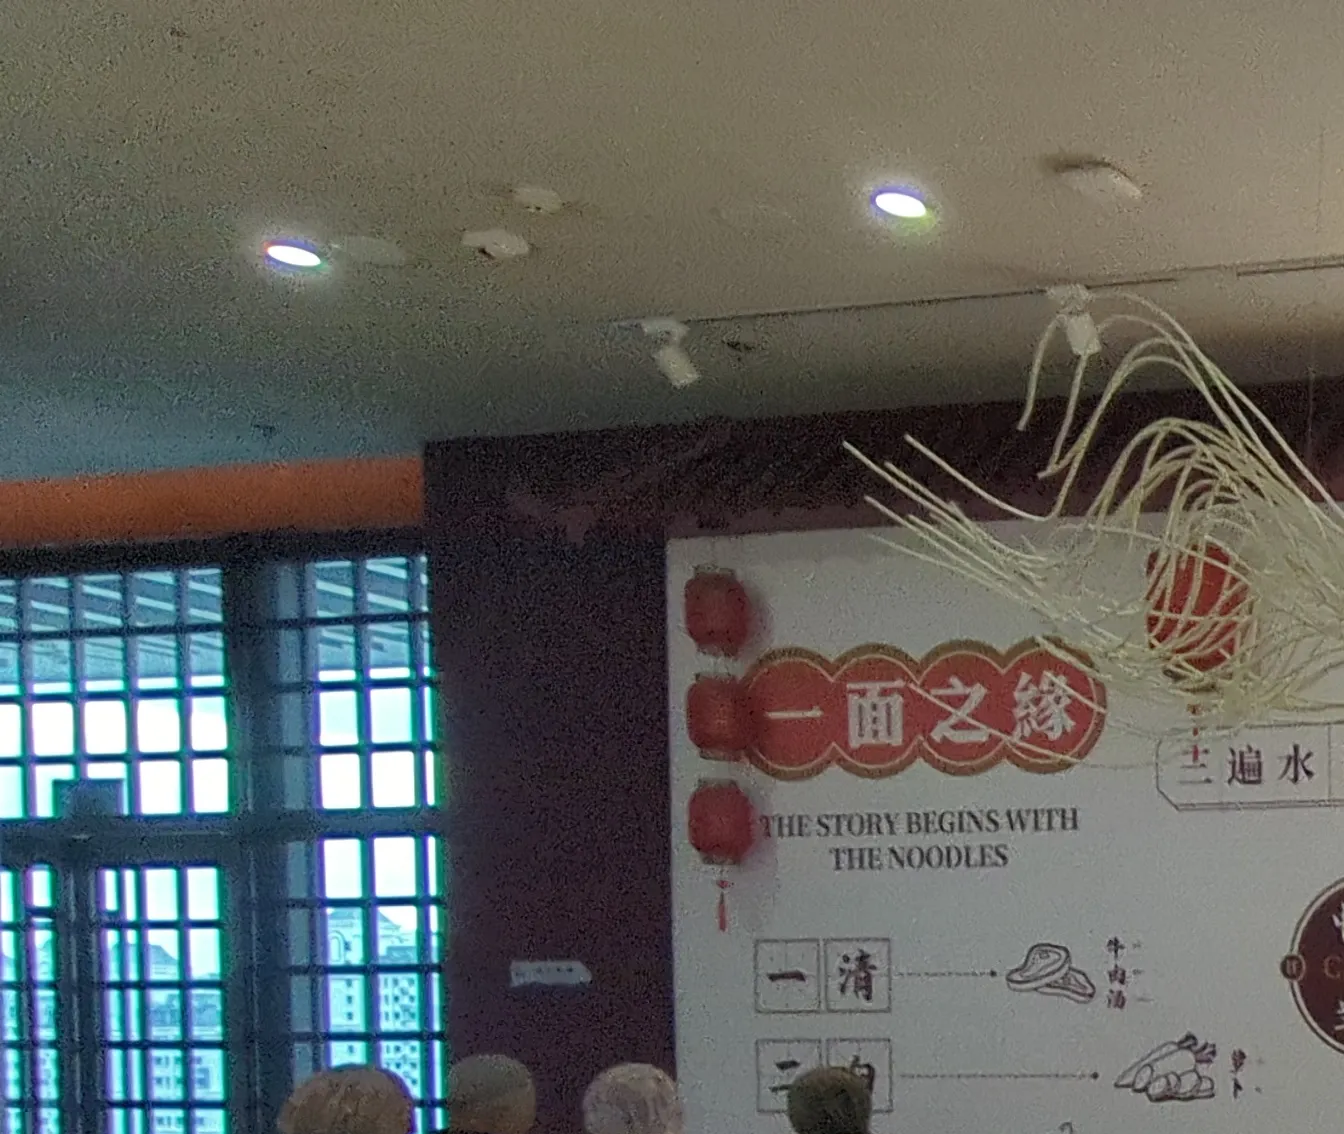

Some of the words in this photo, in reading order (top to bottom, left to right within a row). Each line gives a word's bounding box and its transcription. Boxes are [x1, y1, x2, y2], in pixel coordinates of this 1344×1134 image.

[1176, 744, 1316, 786] 三遍水
[759, 812, 814, 838] THE
[815, 811, 900, 837] STORY
[905, 808, 1000, 835] BEGINS
[1005, 806, 1080, 833] WITH
[829, 846, 882, 871] THE
[887, 843, 1010, 871] NOODLES
[767, 950, 877, 1000] 一清
